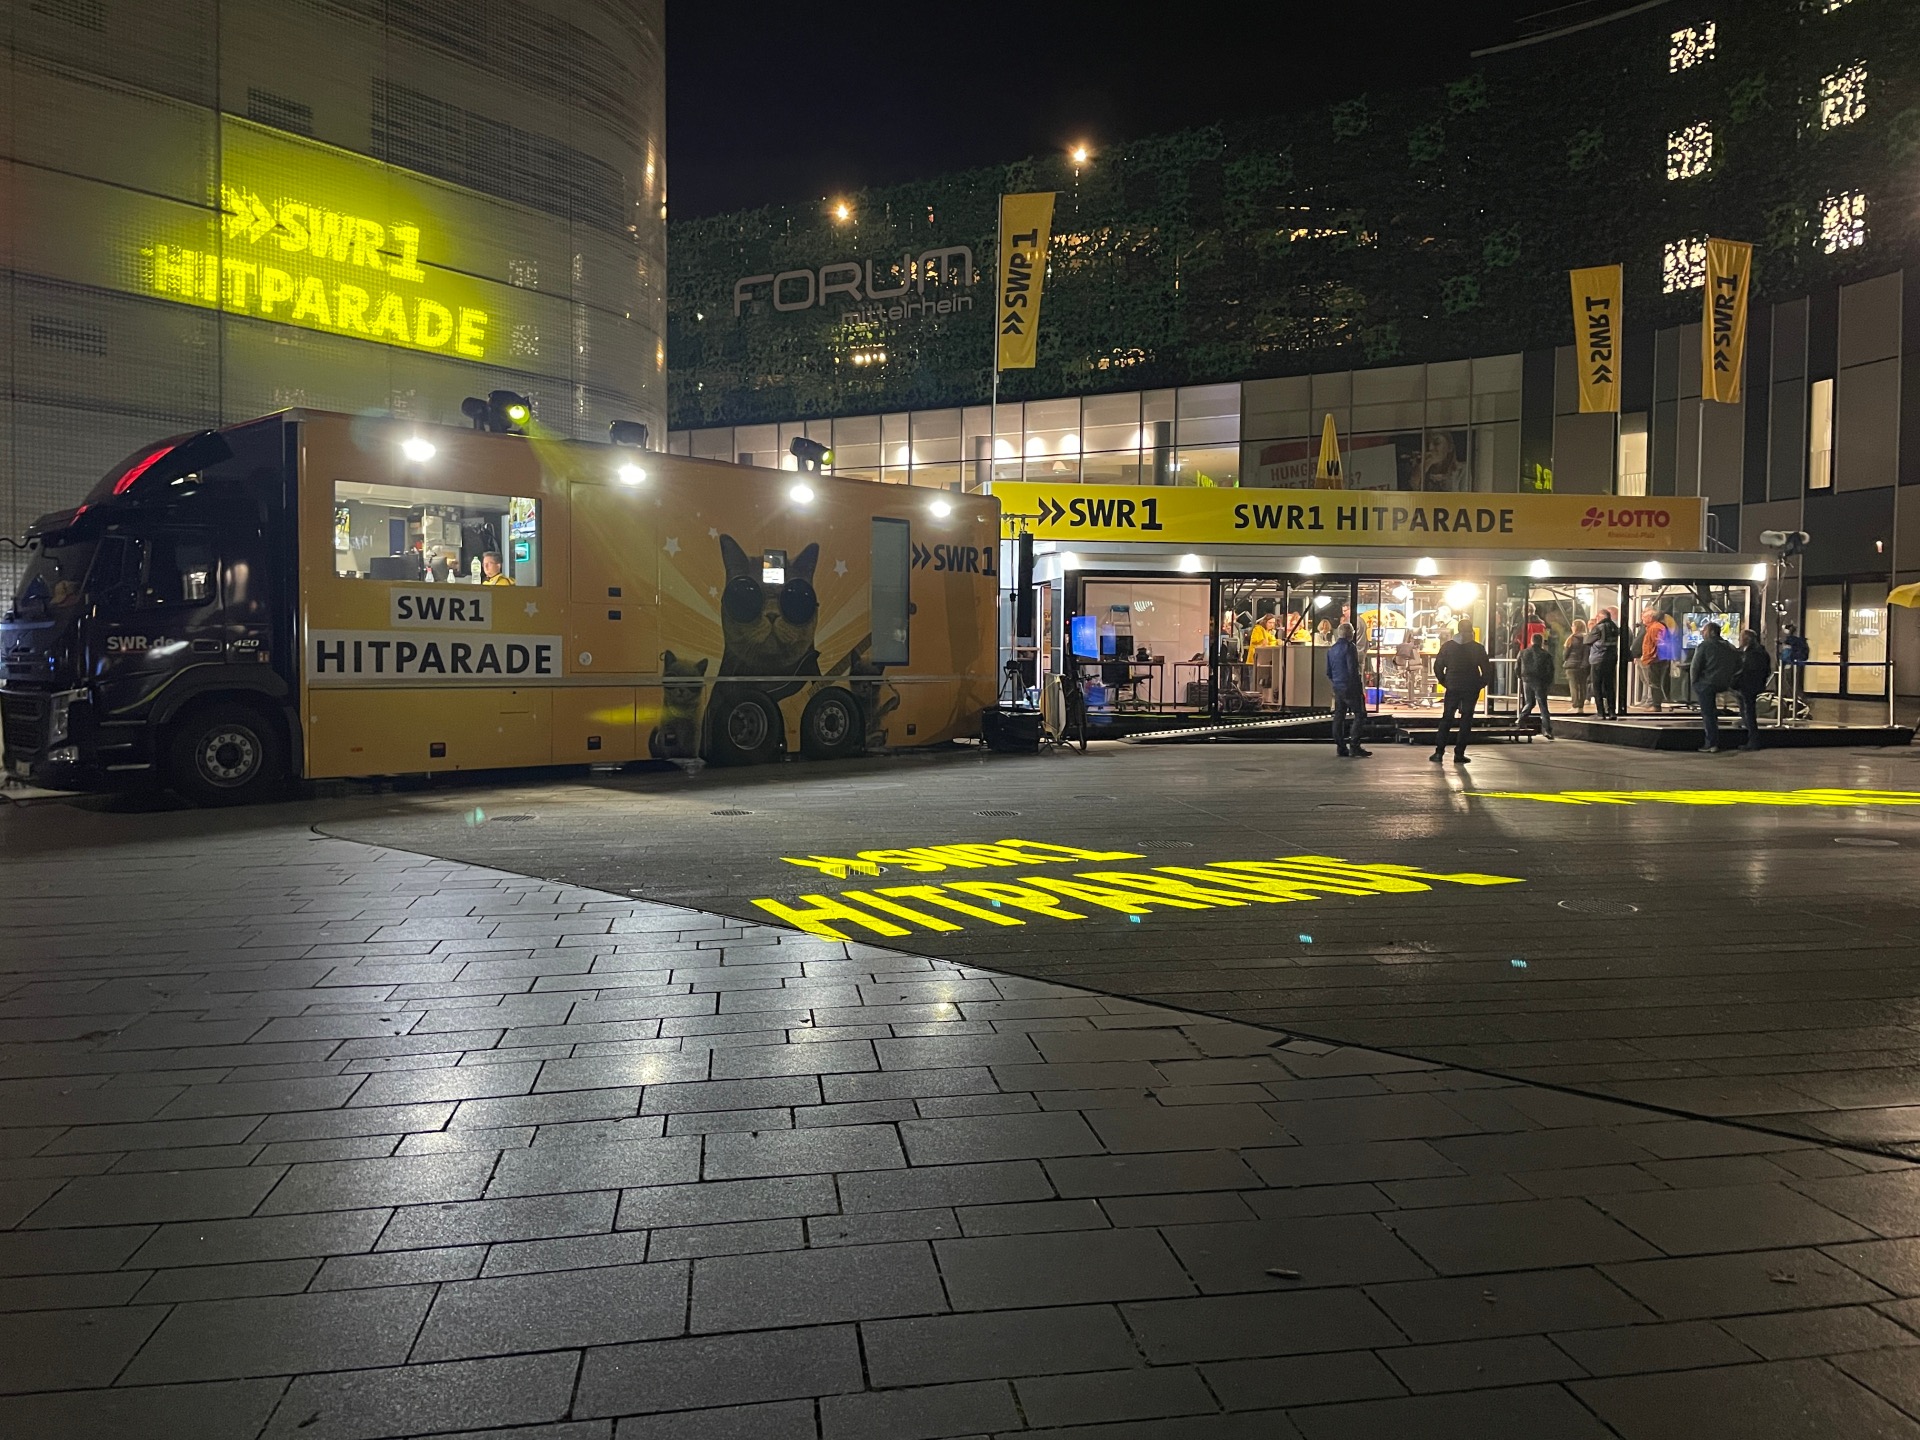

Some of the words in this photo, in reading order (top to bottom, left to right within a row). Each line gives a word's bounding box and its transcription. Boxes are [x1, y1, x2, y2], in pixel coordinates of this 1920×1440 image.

[278, 198, 425, 283] SWR1
[733, 245, 973, 317] FORUM
[152, 244, 488, 357] HITPARADE
[842, 294, 973, 327] mittelrhein
[1713, 274, 1738, 348] SWR1
[1069, 498, 1163, 531] SWR1
[1234, 504, 1324, 529] SWR1
[1337, 506, 1514, 533] HITPARADE
[1608, 509, 1670, 528] LOTTO
[933, 544, 997, 576] SWR1
[397, 595, 485, 622] SWR1
[107, 636, 176, 650] SWR.de
[233, 639, 260, 647] 420
[316, 640, 552, 674] HITPARADE
